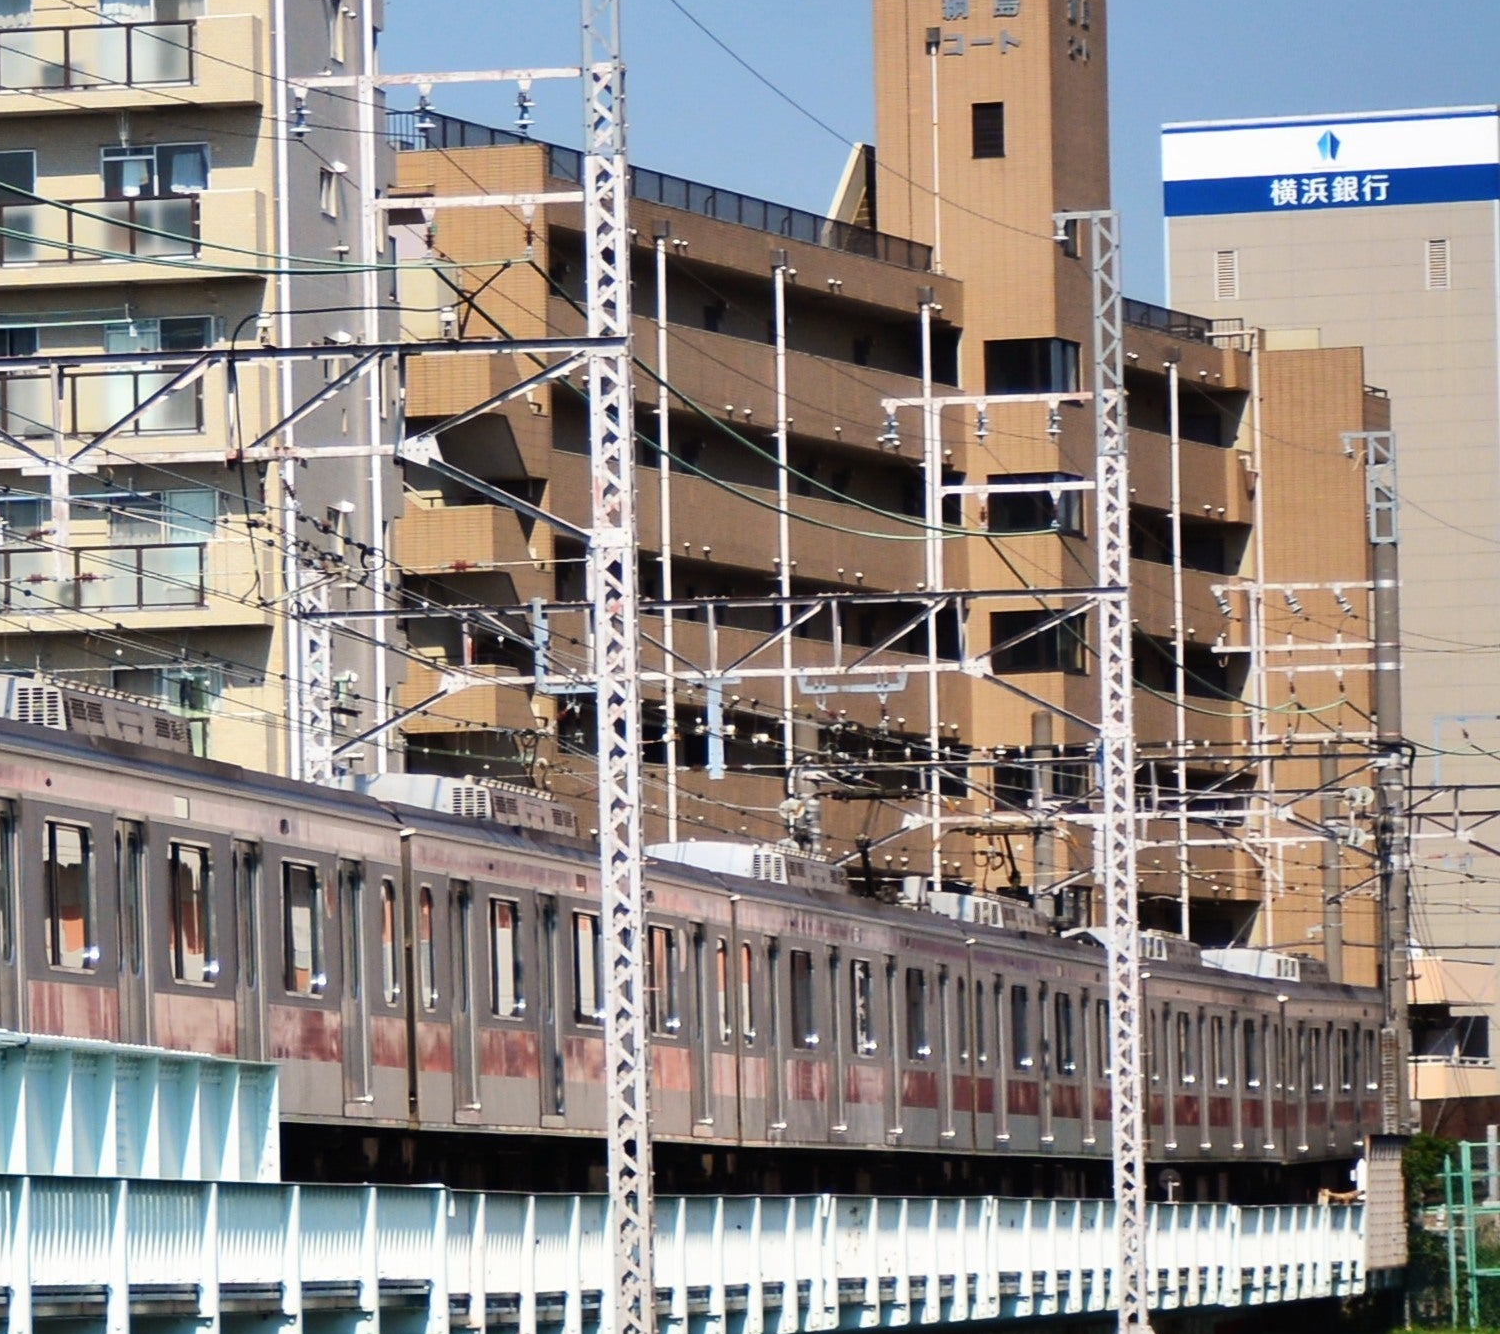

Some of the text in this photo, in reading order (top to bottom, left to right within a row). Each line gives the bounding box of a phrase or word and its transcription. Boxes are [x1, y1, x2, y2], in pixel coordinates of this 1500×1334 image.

[943, 30, 1020, 56] コート
[1270, 174, 1390, 206] 横浜銀行
